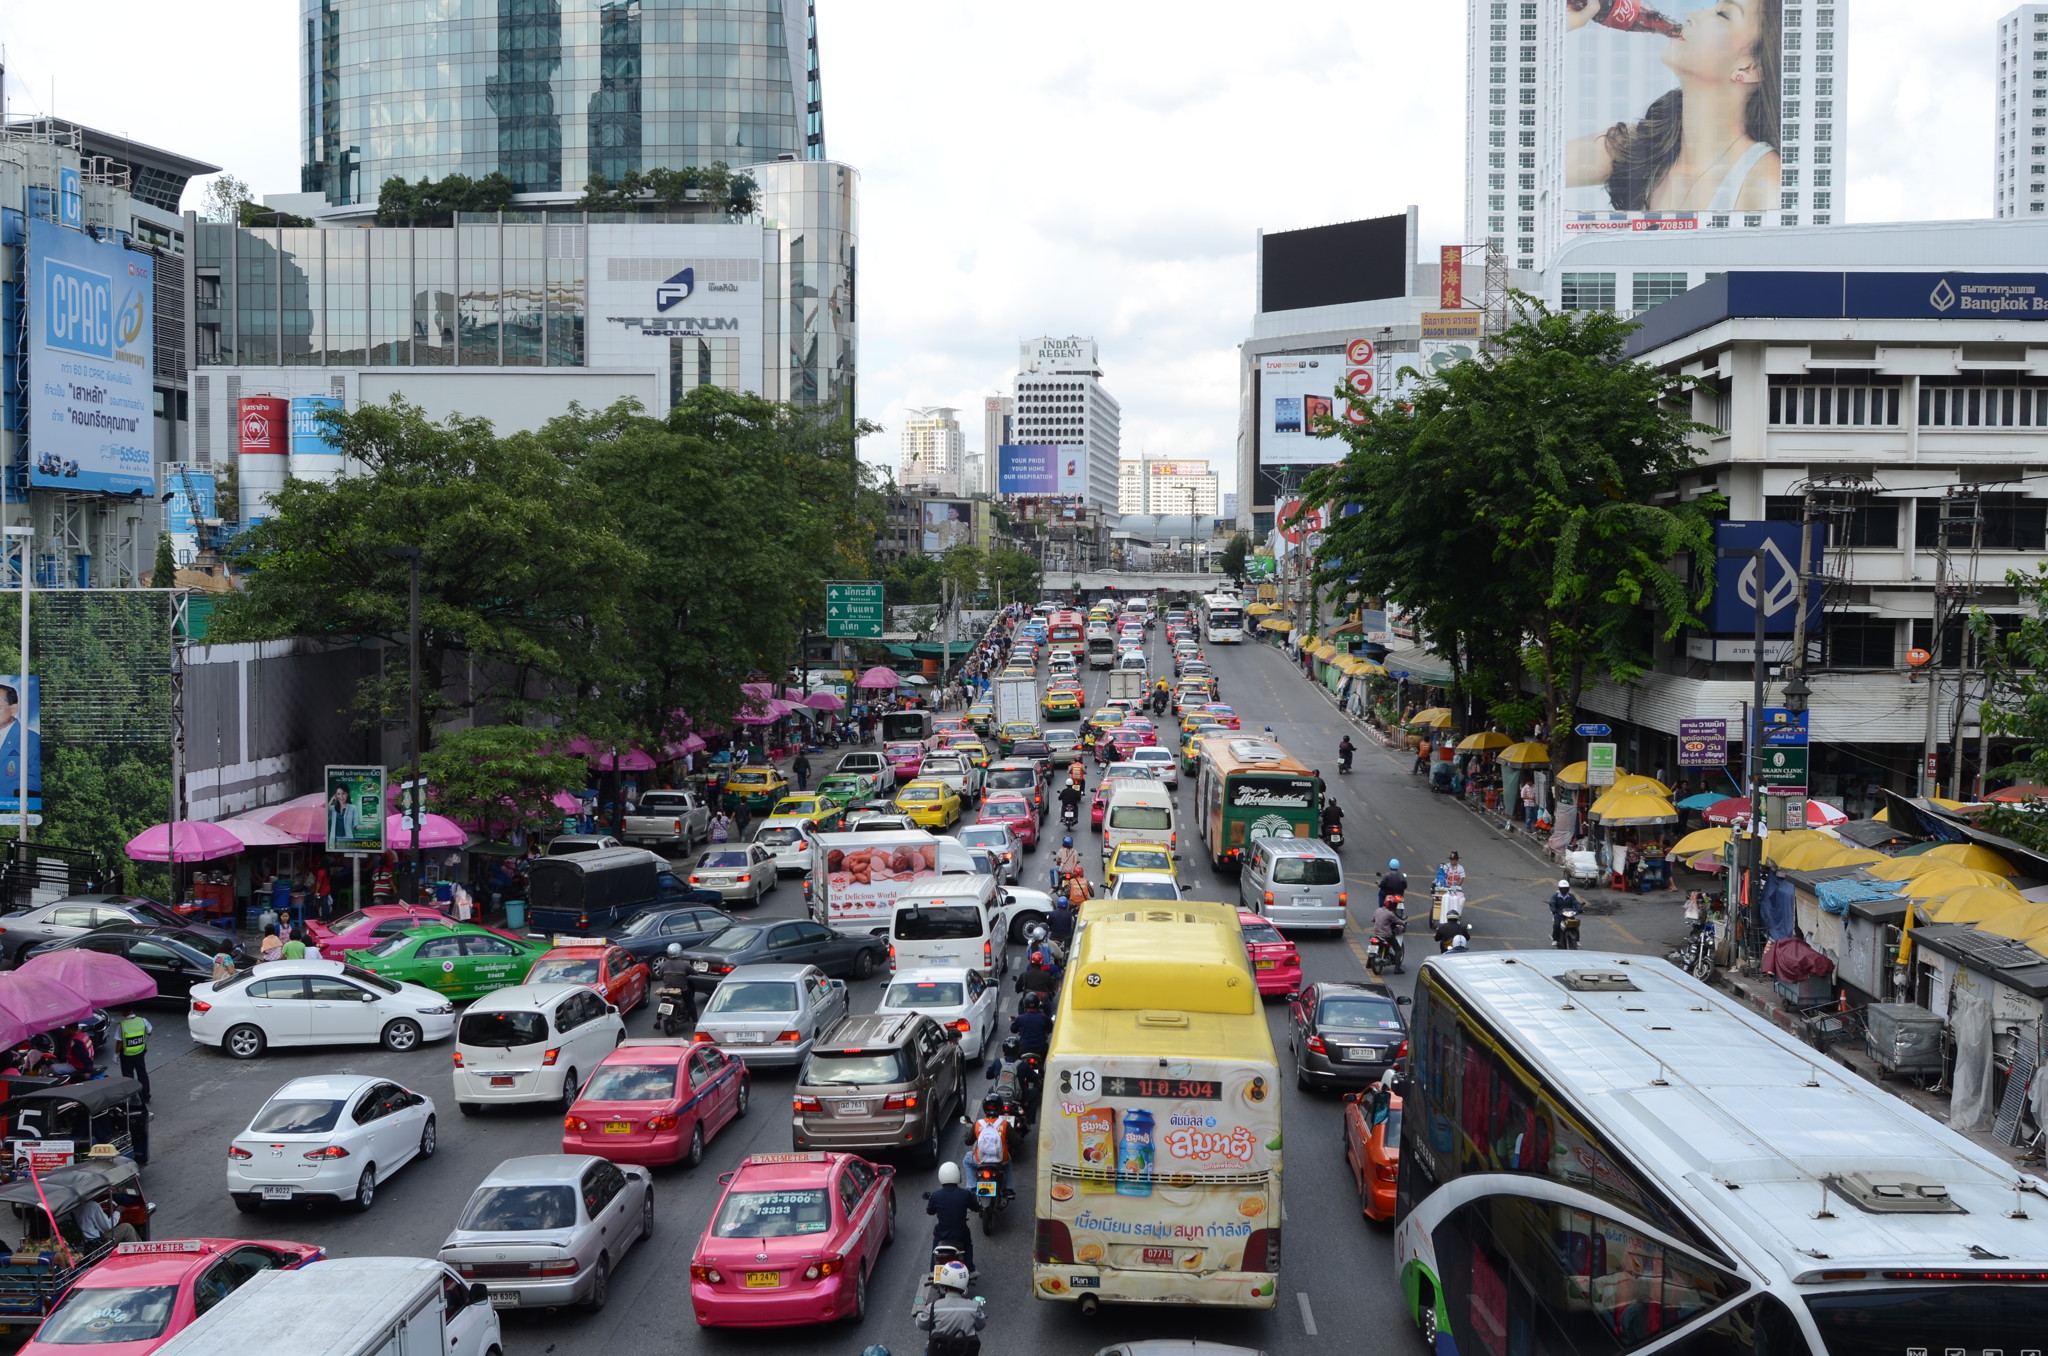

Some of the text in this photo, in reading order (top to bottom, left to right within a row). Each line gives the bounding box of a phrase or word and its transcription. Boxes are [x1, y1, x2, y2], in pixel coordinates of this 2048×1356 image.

[1443, 249, 1461, 306] 李海泉
[1961, 285, 2035, 297] ธนาคารกรุงเทพ
[53, 273, 107, 347] CPAC
[1961, 296, 2028, 313] Bangkok
[1424, 328, 1477, 336] DRAGON RESTAURANT
[1043, 340, 1078, 349] INDRA
[1039, 349, 1083, 358] REGENT
[845, 586, 876, 596] มักกะสัน
[847, 604, 874, 613] ดินแดง
[840, 620, 859, 630] อโศก
[1087, 975, 1100, 986] 52
[1072, 1070, 1095, 1092] 18
[1062, 1101, 1085, 1115] ใหม่
[17, 1109, 42, 1138] 5
[1170, 1127, 1253, 1161] สมูทตี้
[94, 1146, 111, 1154] TAXI
[740, 1195, 811, 1206] 02-613-8000
[1074, 1210, 1252, 1241] เนื้อเนียน รสนุ่ม สมูท กำลังดี
[760, 1272, 778, 1281] 2470
[1072, 1277, 1088, 1285] Plan
[500, 1292, 517, 1300] 6305
